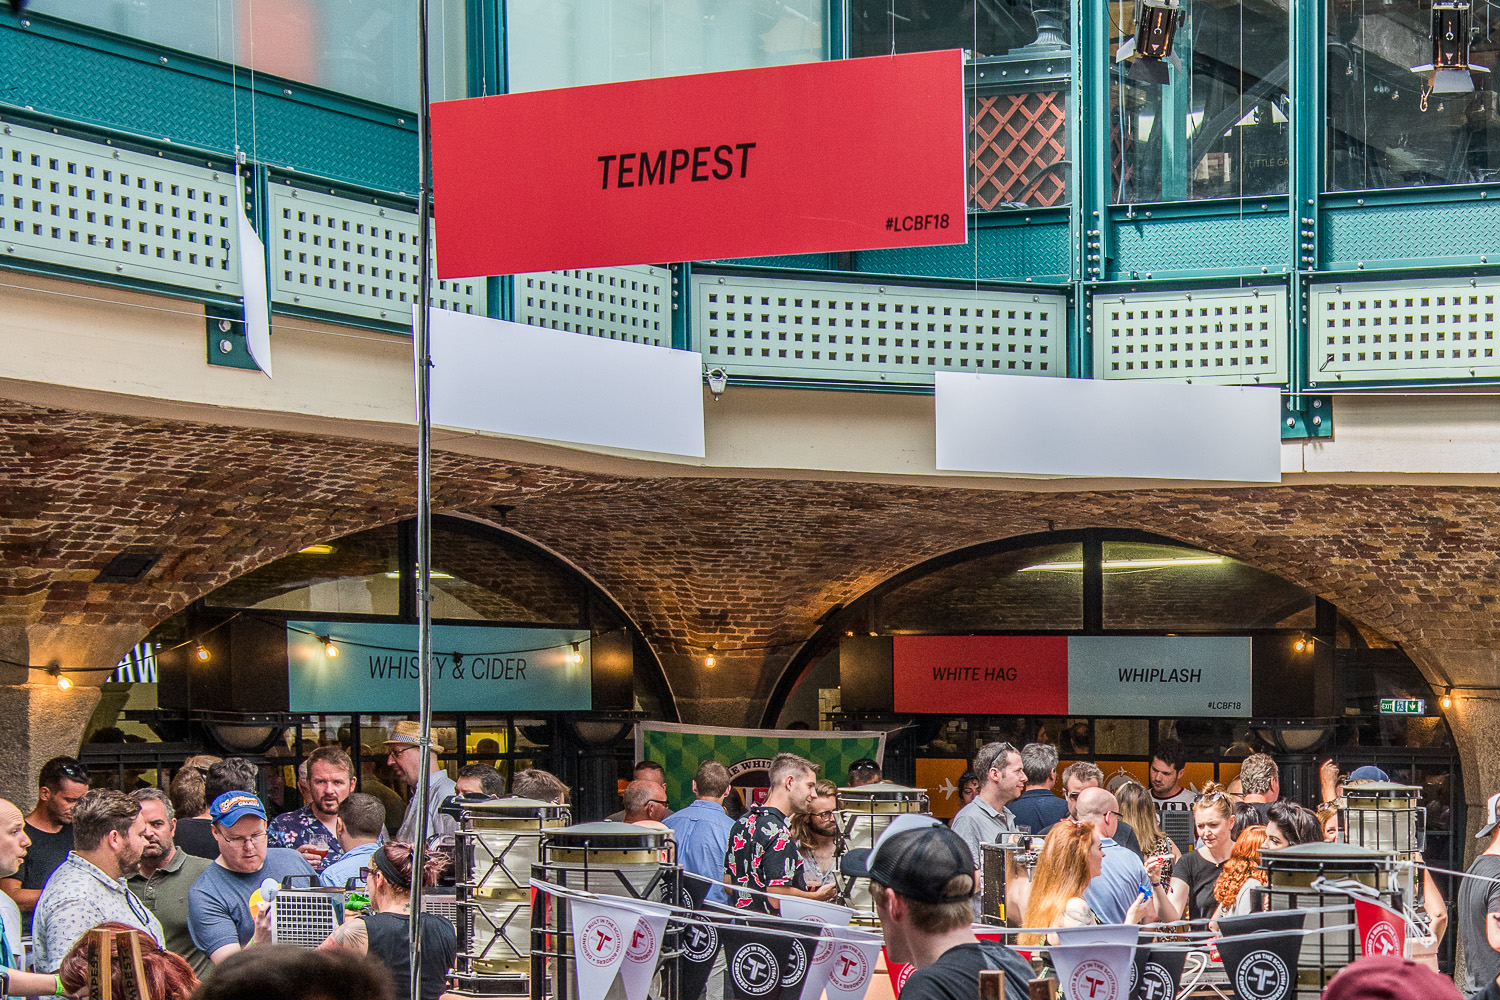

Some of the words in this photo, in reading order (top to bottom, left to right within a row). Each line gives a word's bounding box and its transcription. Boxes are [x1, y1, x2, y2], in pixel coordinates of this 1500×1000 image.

[597, 142, 756, 190] TEMPEST
[1276, 157, 1290, 167] GA
[885, 213, 950, 232] #LCBF18
[369, 655, 447, 679] WHISY
[452, 657, 465, 680] &
[471, 657, 527, 680] CIDER
[932, 667, 981, 682] WHITE
[984, 667, 1018, 682] HAG
[1118, 668, 1202, 683] WHIPLASH
[1207, 701, 1242, 710] #LCBF18
[741, 760, 772, 770] WHIT
[1241, 955, 1255, 970] BUILT
[1261, 953, 1273, 961] THE
[1272, 957, 1286, 986] SCOTTISH
